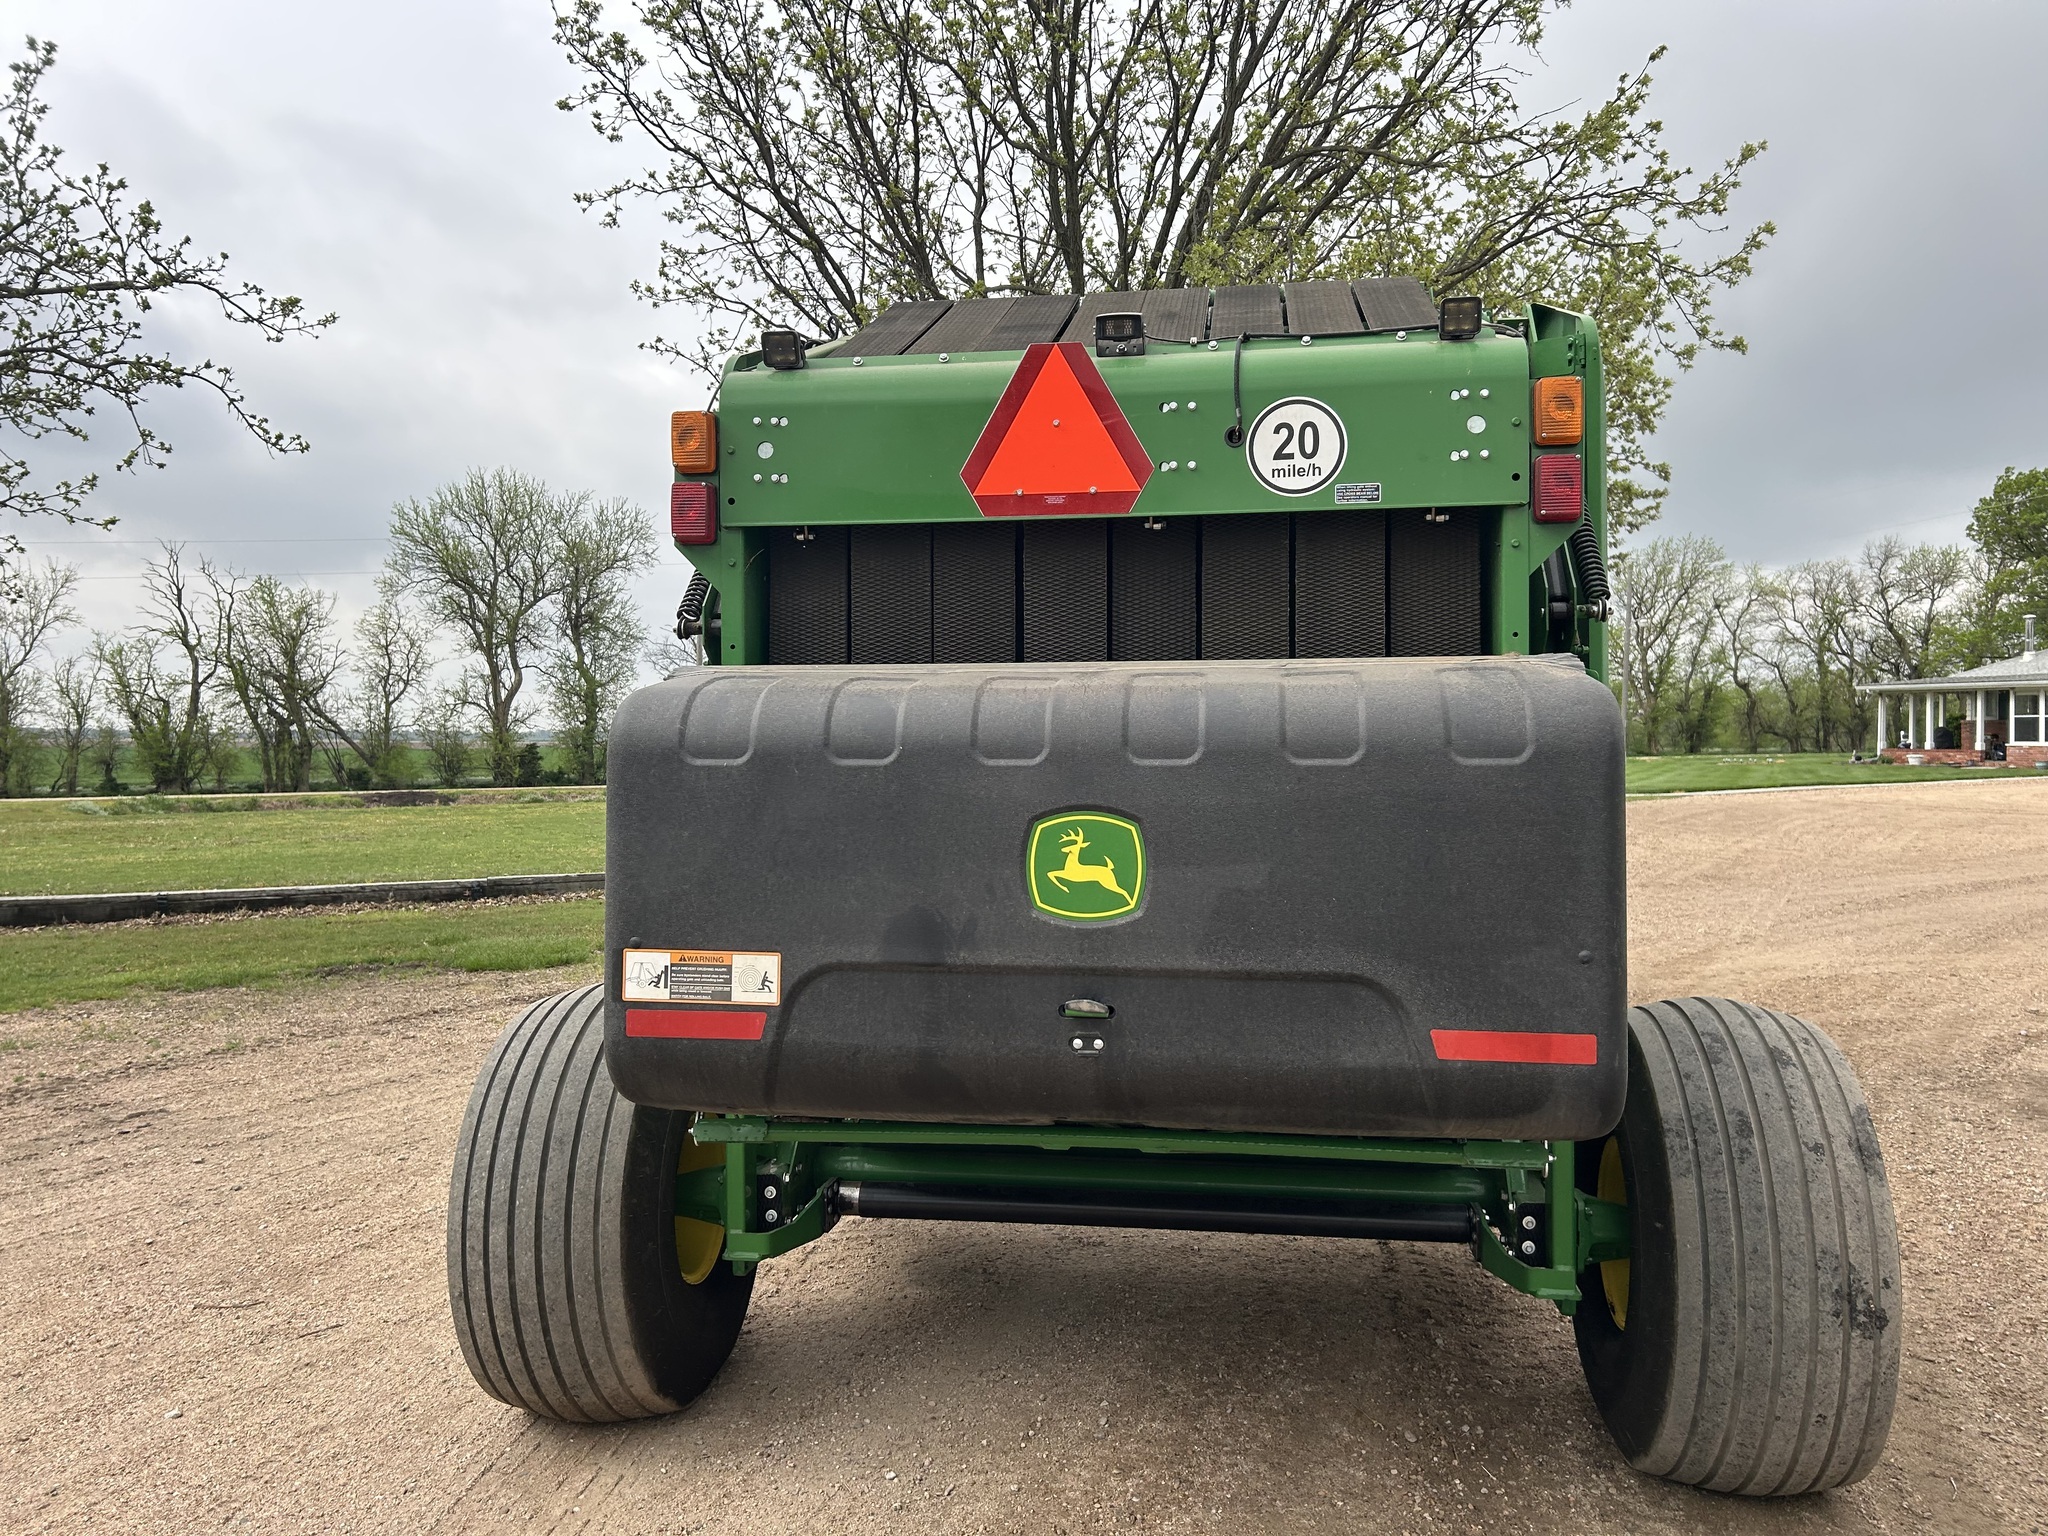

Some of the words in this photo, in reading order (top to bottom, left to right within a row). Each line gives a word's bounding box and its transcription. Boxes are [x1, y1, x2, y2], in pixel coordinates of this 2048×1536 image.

[1272, 420, 1320, 461] 20
[1271, 463, 1322, 479] mile/h
[687, 955, 724, 963] WARNING
